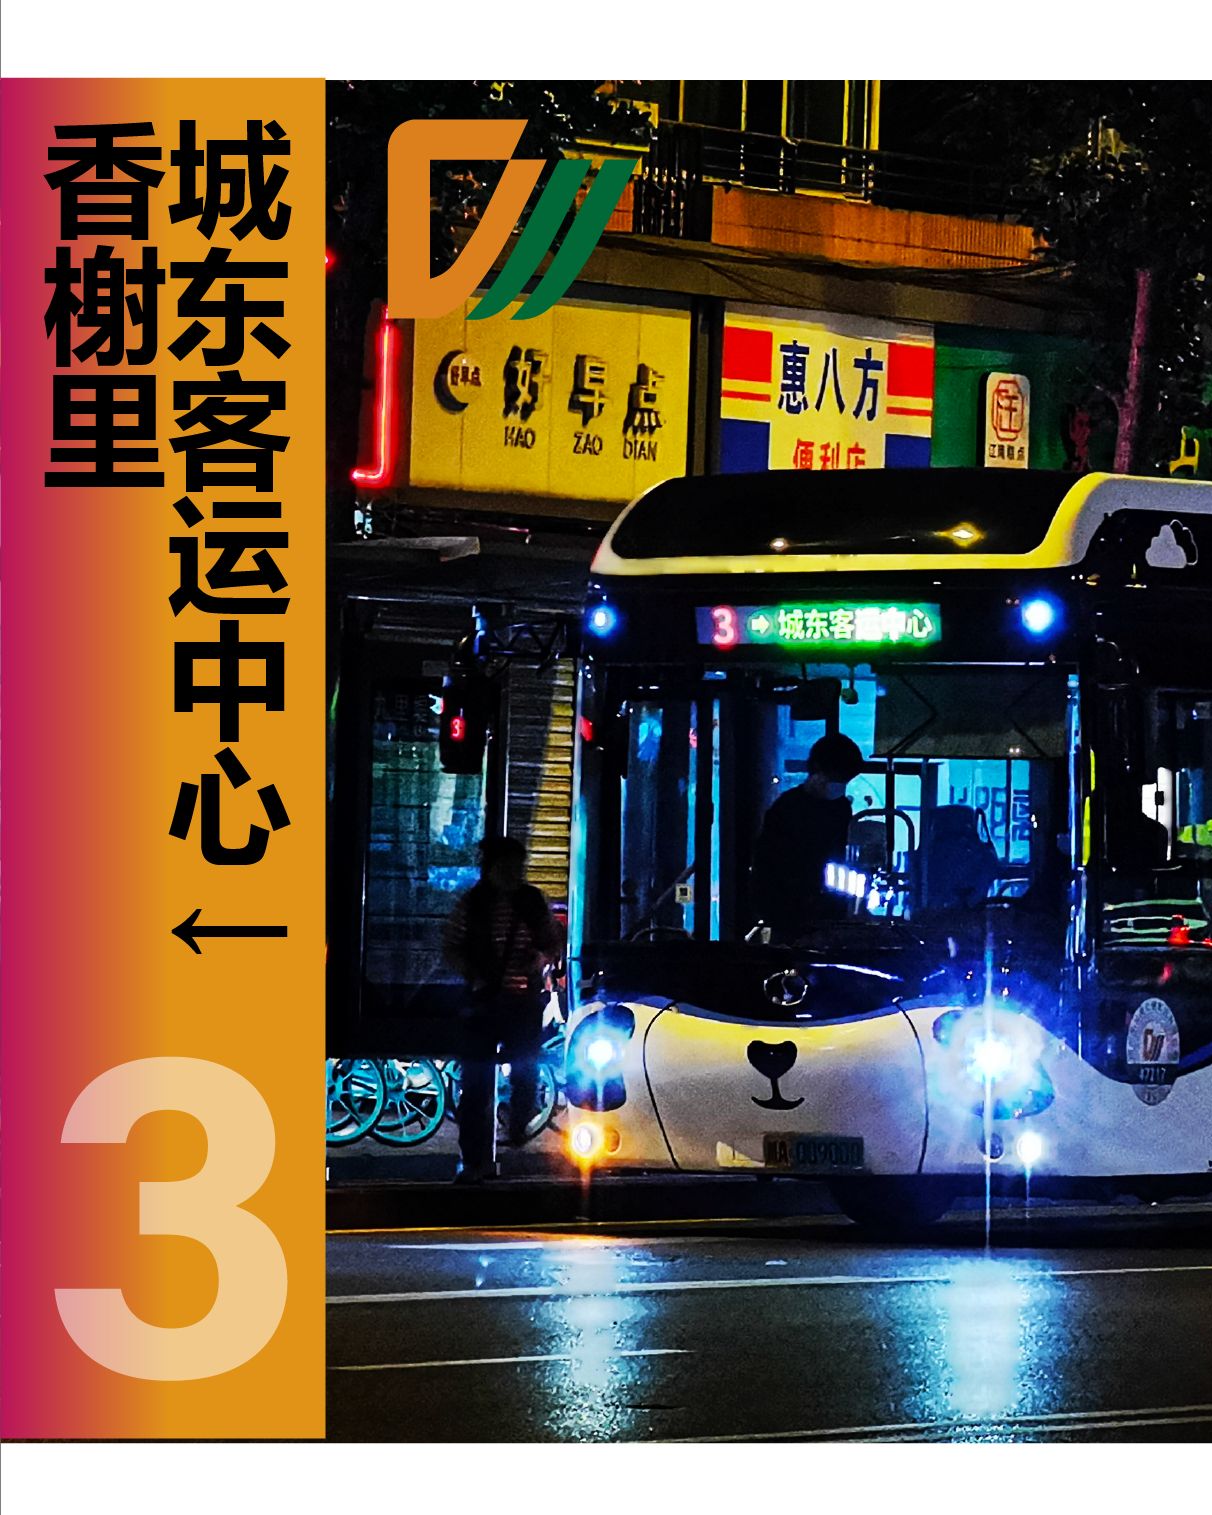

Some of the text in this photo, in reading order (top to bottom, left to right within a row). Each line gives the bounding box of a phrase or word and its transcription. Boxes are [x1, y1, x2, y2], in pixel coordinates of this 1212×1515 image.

[502, 345, 664, 436] 好早点
[778, 339, 884, 422] 惠八方
[504, 426, 658, 462] HAO ZAO DIAN
[712, 607, 736, 645] 3
